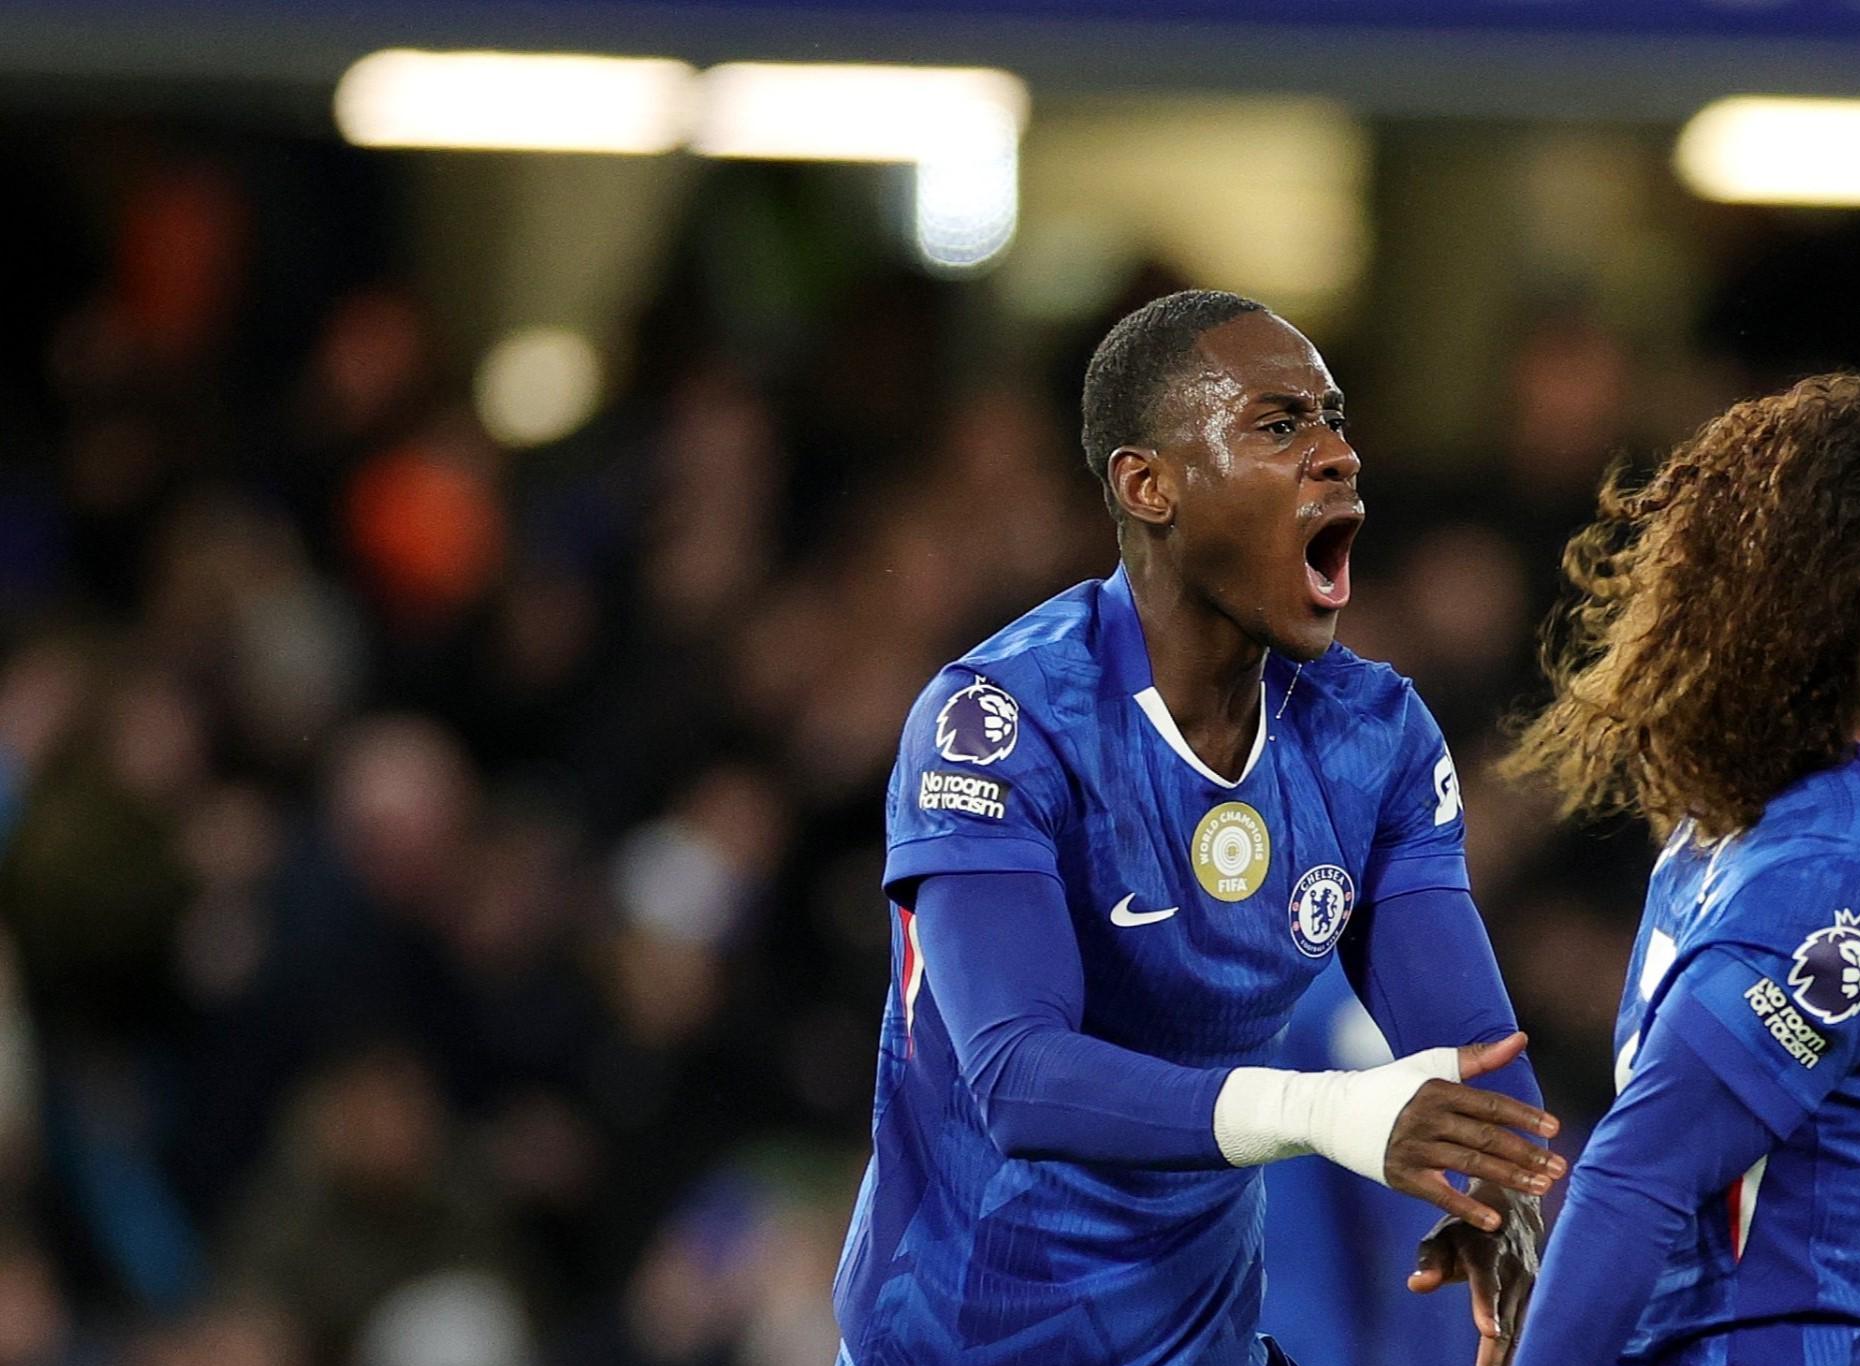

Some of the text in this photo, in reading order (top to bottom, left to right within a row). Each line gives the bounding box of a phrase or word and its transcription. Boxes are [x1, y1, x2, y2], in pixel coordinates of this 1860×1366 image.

[922, 771, 1000, 800] No room
[941, 792, 1005, 819] racism
[1200, 819, 1219, 865] WORLD
[1218, 877, 1248, 893] FIFA
[1301, 869, 1345, 891] CHELSEA
[1756, 977, 1826, 1052] No room
[1764, 1013, 1819, 1069] racism
